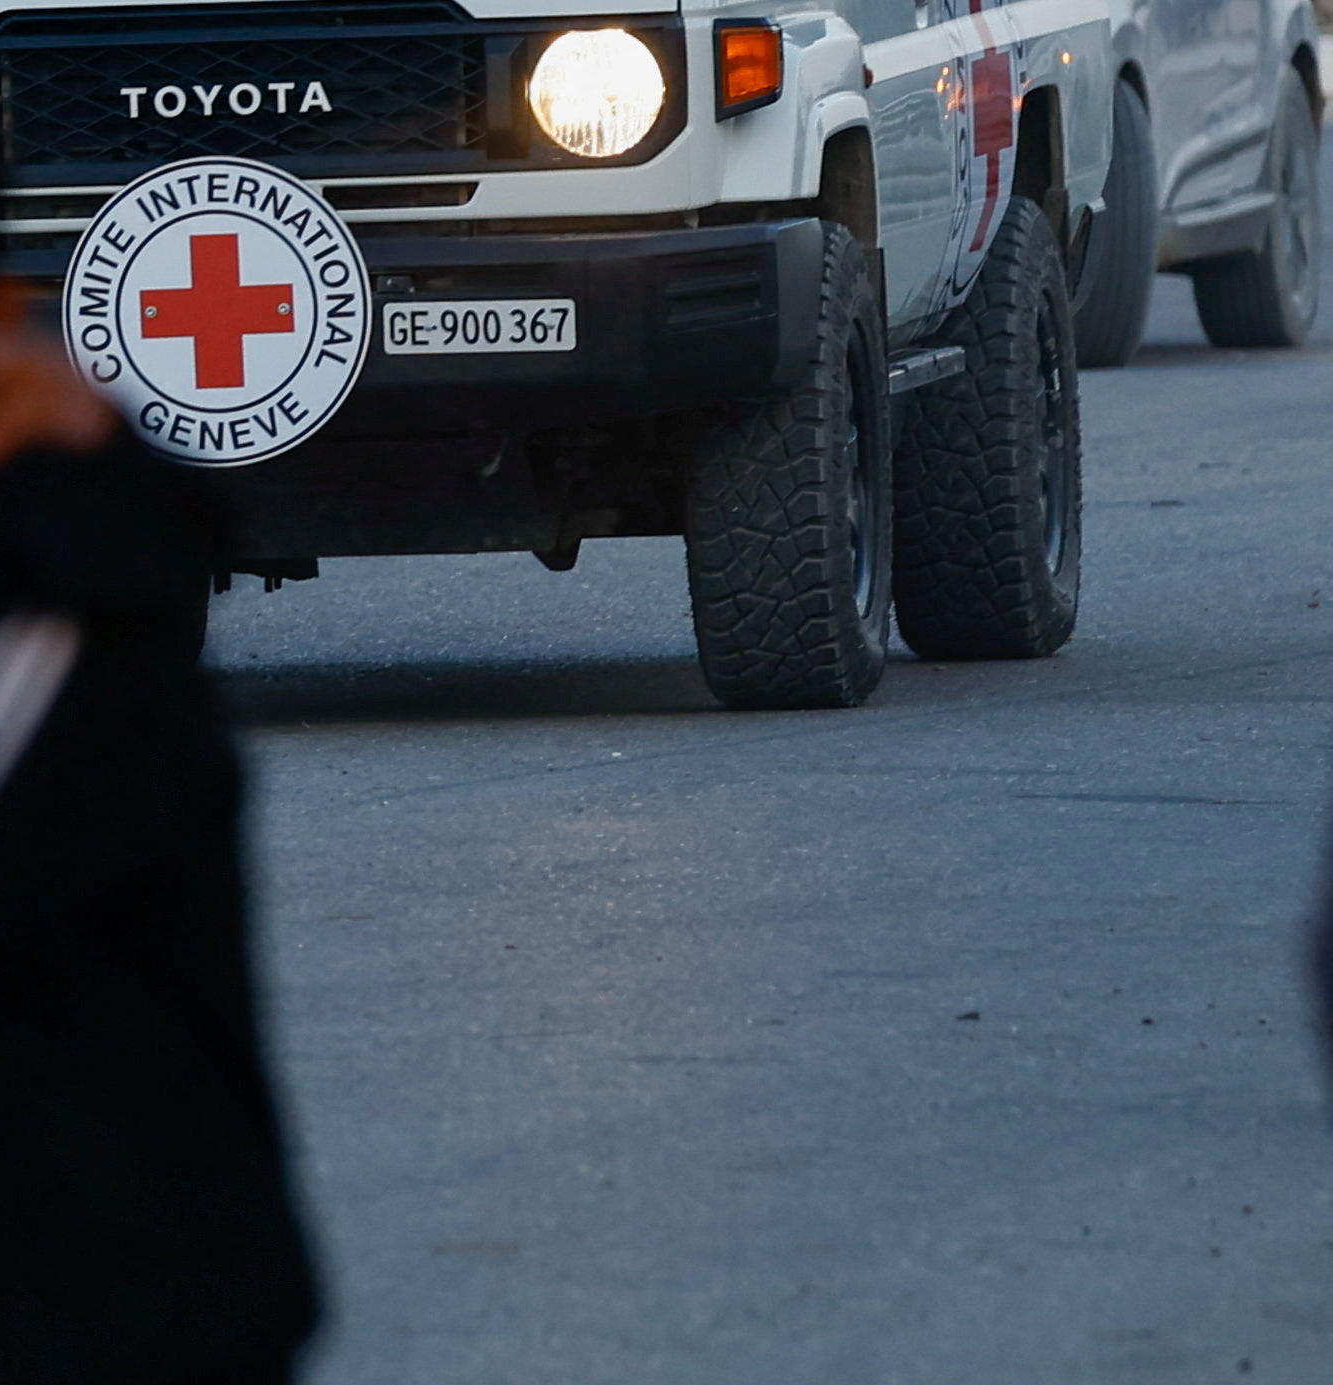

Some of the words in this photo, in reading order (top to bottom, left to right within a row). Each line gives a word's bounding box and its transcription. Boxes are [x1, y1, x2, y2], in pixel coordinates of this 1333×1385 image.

[120, 81, 333, 119] TOYOTA
[79, 220, 136, 384] COMITE
[136, 173, 356, 368] INTERNATIONAL
[509, 307, 570, 344] 367
[139, 391, 309, 451] GENEVE
